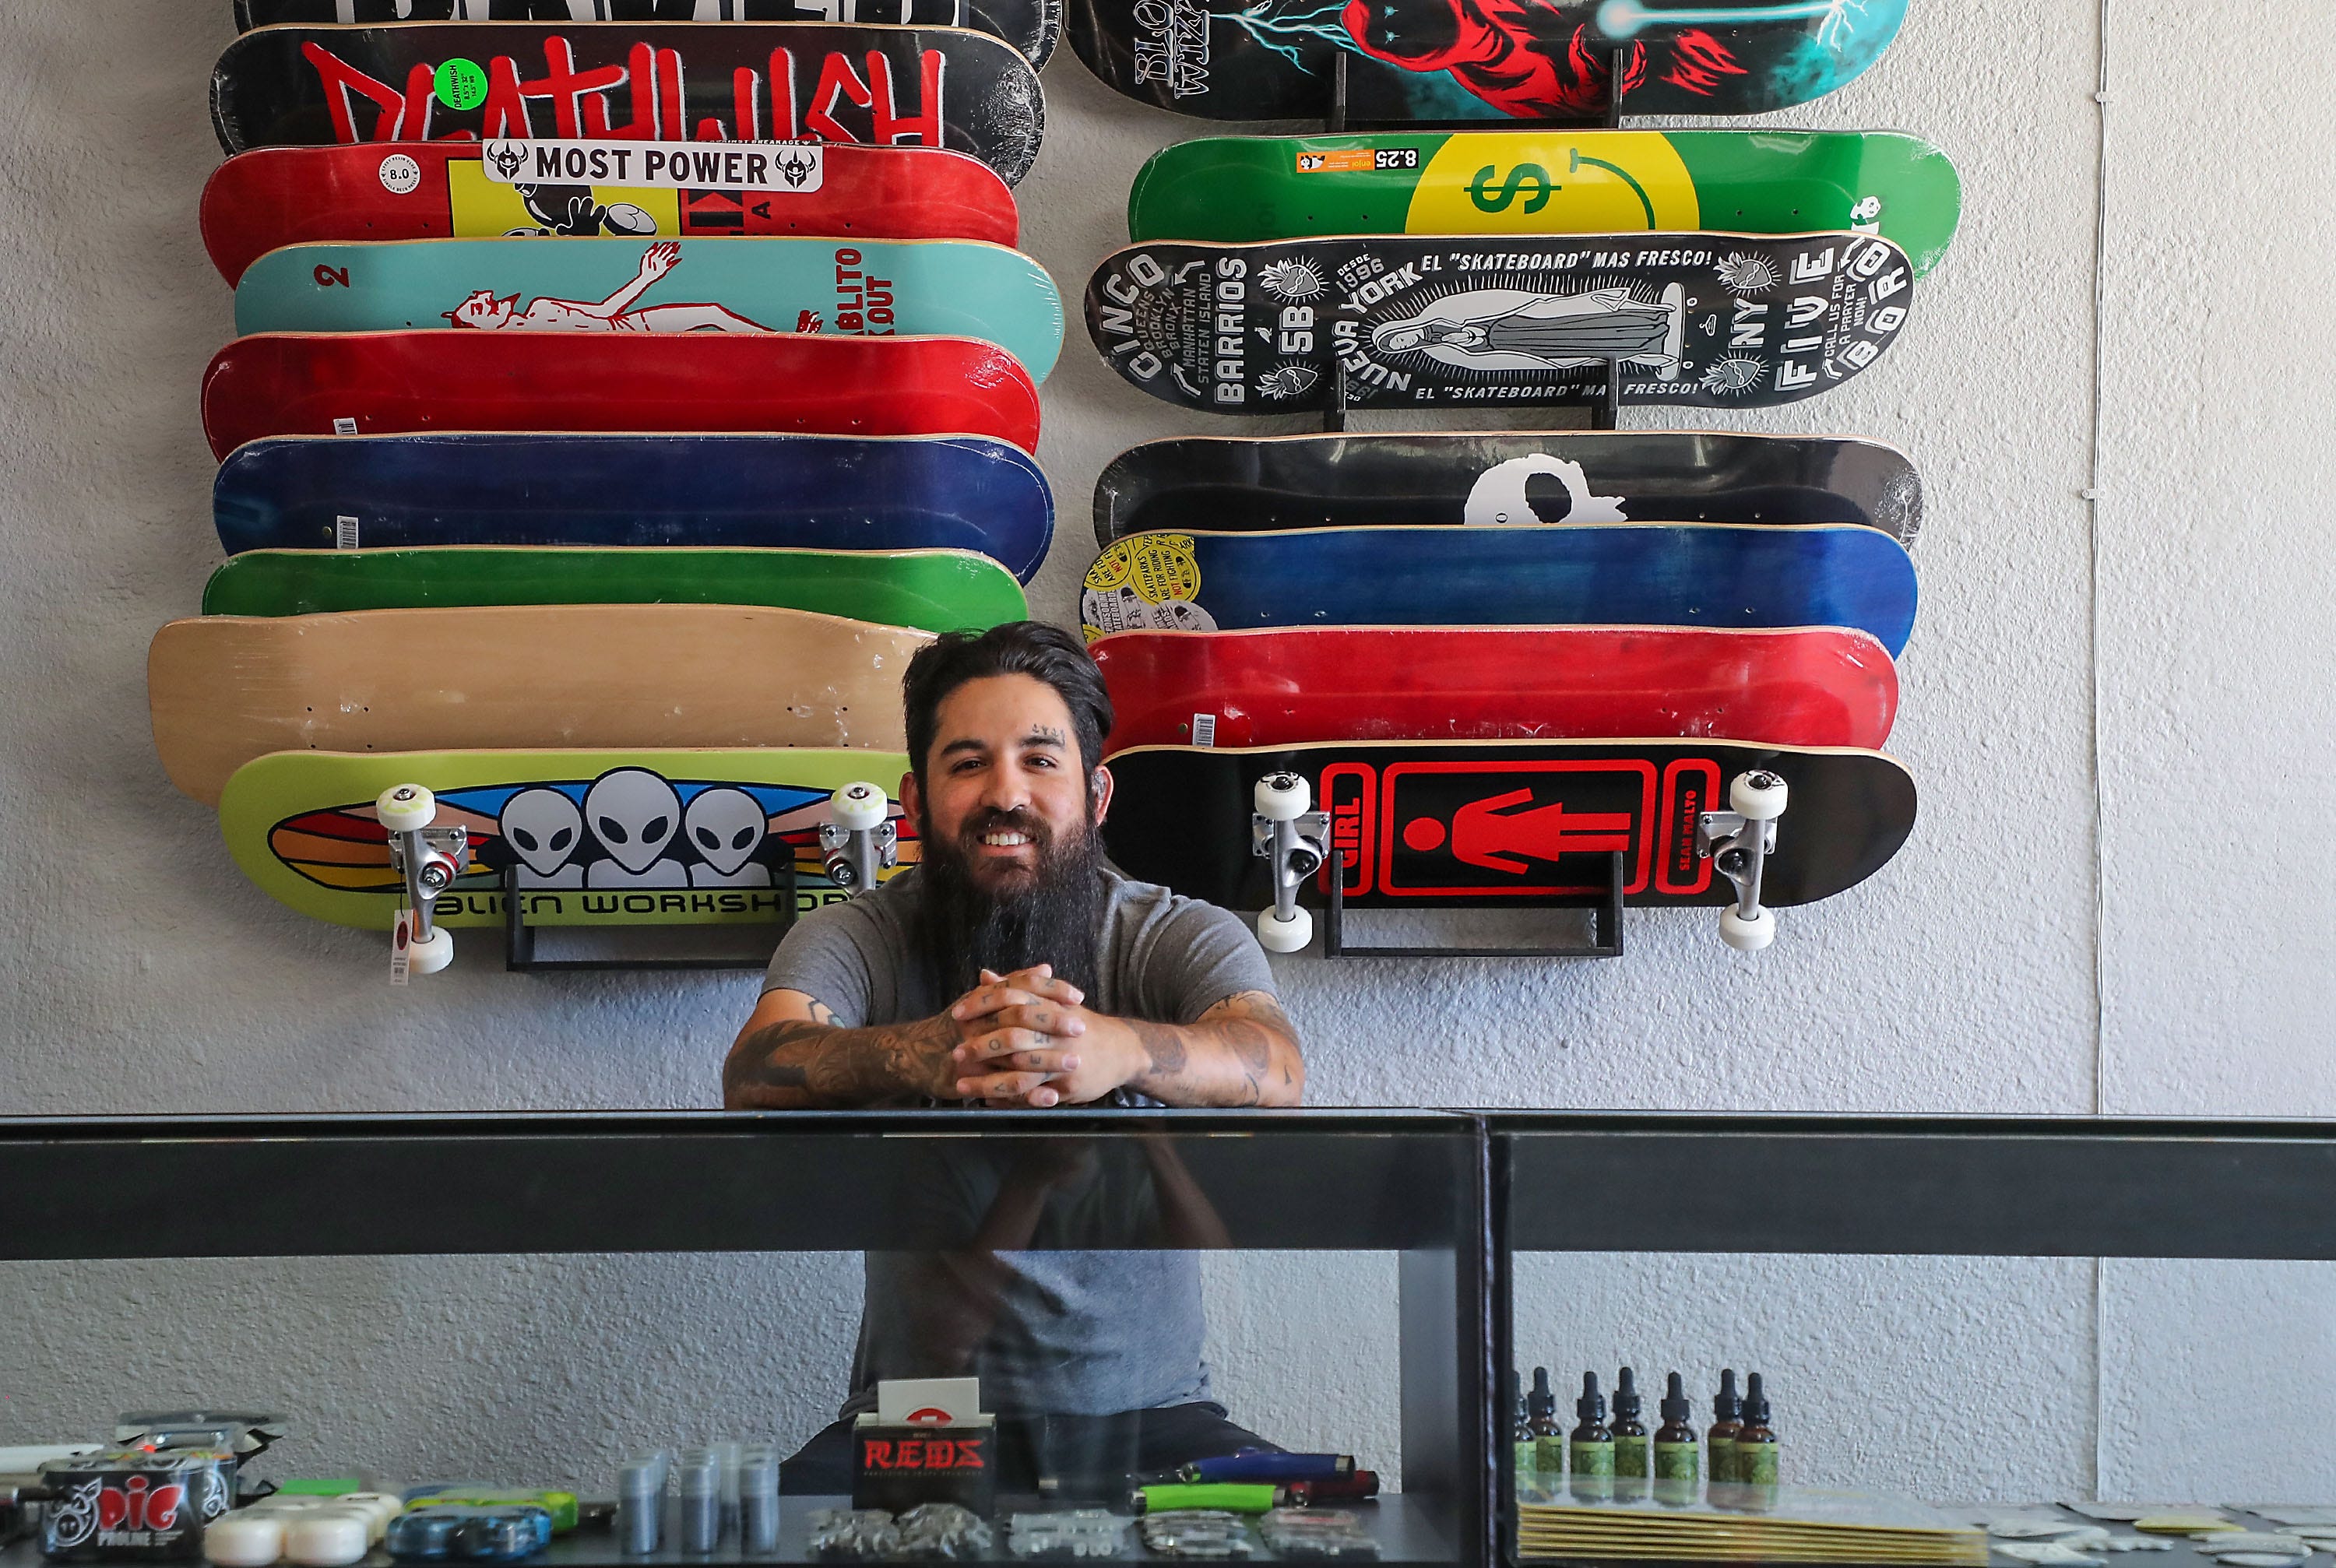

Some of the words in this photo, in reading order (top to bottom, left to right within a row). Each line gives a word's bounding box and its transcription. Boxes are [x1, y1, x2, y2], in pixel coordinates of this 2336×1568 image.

[449, 65, 462, 107] DEATHWISH
[390, 168, 410, 180] 8.0
[537, 147, 632, 181] MOST
[646, 150, 768, 185] POWER
[1375, 149, 1417, 168] 8.25
[314, 264, 350, 288] 2
[1335, 258, 1384, 294] 1996
[1336, 253, 1370, 276] DESDE
[1420, 255, 1443, 271] EL
[1448, 250, 1590, 272] "SKATEBOARD"
[1592, 251, 1630, 269] MAS
[1634, 249, 1712, 267] FRESCO!
[835, 248, 864, 336] BLITO
[1198, 272, 1211, 323] ISLAND
[1339, 262, 1423, 314] YORK
[1831, 274, 1845, 300] FOR
[1100, 254, 1165, 381] CINCO
[1135, 290, 1155, 351] QUEENS
[1149, 287, 1175, 359] BROOKLYN
[1774, 247, 1835, 392] FIVE
[1829, 303, 1841, 322] US
[1837, 241, 1908, 371] BORO
[1840, 283, 1857, 333] PRAYER
[1853, 296, 1868, 327] NOW!
[1165, 302, 1183, 350] BRONX
[1182, 287, 1196, 367] MANHATTAN
[1215, 257, 1247, 405] BARRIOS
[1729, 297, 1769, 350] NY
[1838, 334, 1851, 345] A
[1198, 329, 1210, 384] STATEN
[1332, 320, 1412, 392] NUEVA
[1824, 325, 1838, 358] CALL
[1415, 387, 1435, 400] EL
[1444, 384, 1579, 399] "SKATEBOARD"
[1582, 385, 1607, 397] MA
[1624, 382, 1698, 396] FRESCO!
[1096, 559, 1106, 569] FO
[1109, 559, 1123, 573] NOT
[1137, 556, 1159, 599] SKATEPARKS
[1149, 549, 1163, 572] RIDING
[1161, 550, 1178, 581] FIGHTING
[1156, 574, 1167, 586] FOR
[1160, 588, 1171, 600] ARE
[1170, 582, 1183, 596] NOT
[1100, 602, 1115, 633] PONSOR
[1683, 789, 1697, 835] MALTO
[1334, 797, 1360, 868] GIRL
[1679, 838, 1694, 871] SEAN
[864, 1440, 987, 1470] REDS
